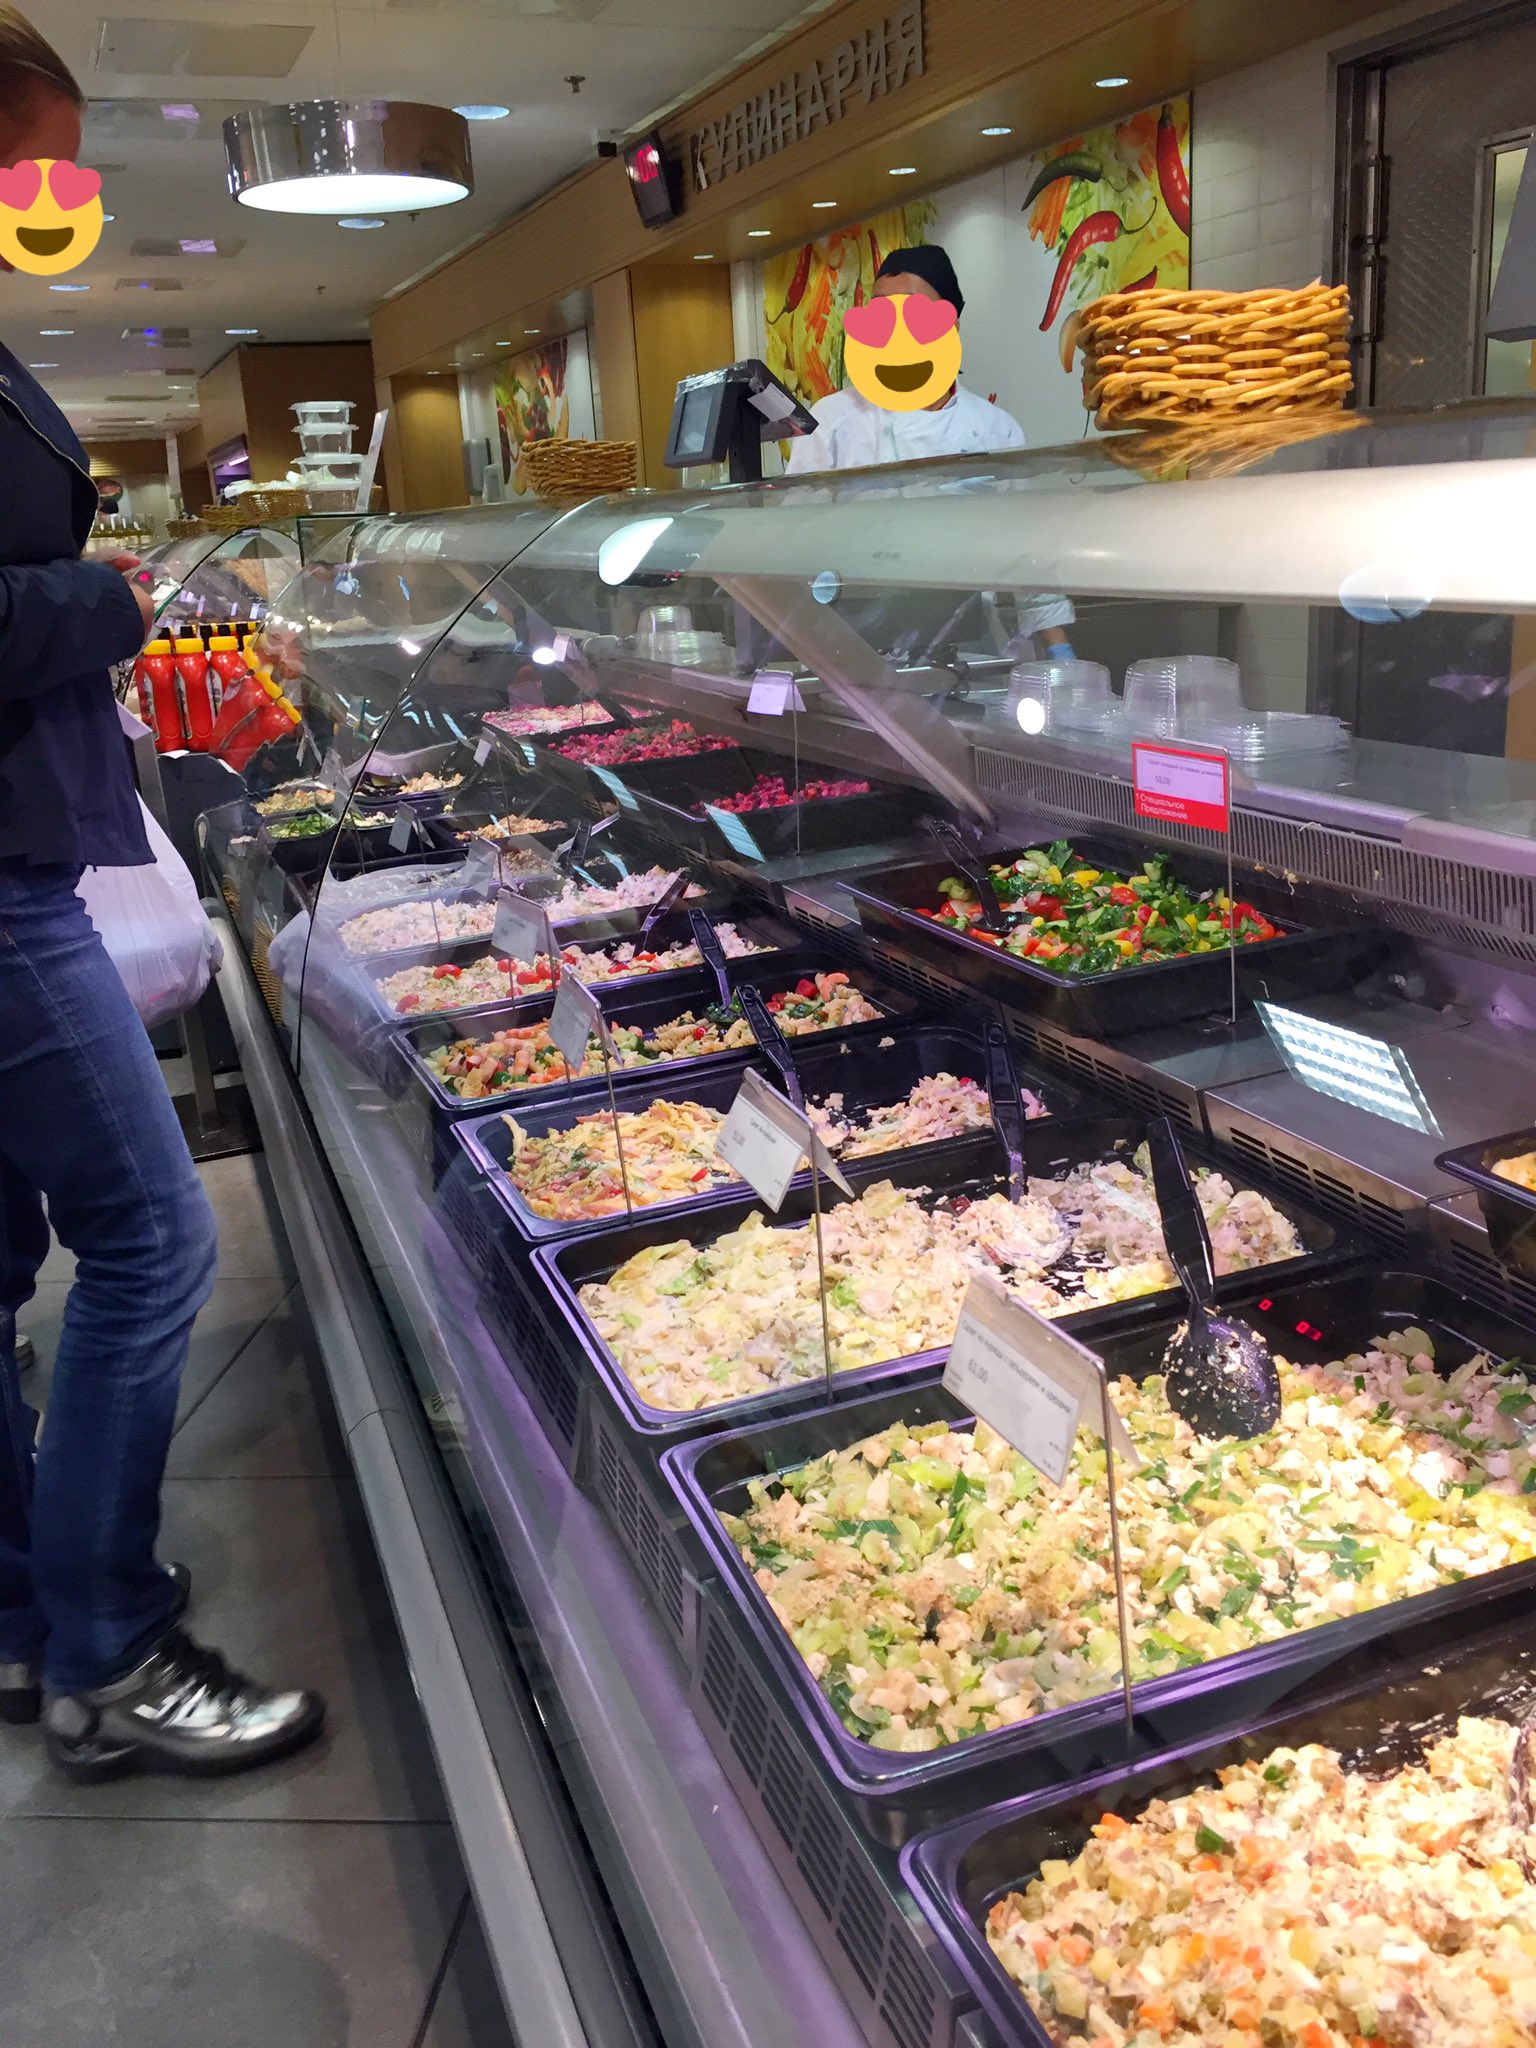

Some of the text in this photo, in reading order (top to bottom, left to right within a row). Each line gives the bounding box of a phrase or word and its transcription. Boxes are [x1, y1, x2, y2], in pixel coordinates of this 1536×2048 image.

[690, 0, 922, 193] КУЛИНАРИЯ
[1140, 793, 1185, 810] Специальное
[1141, 803, 1188, 819] Предложение
